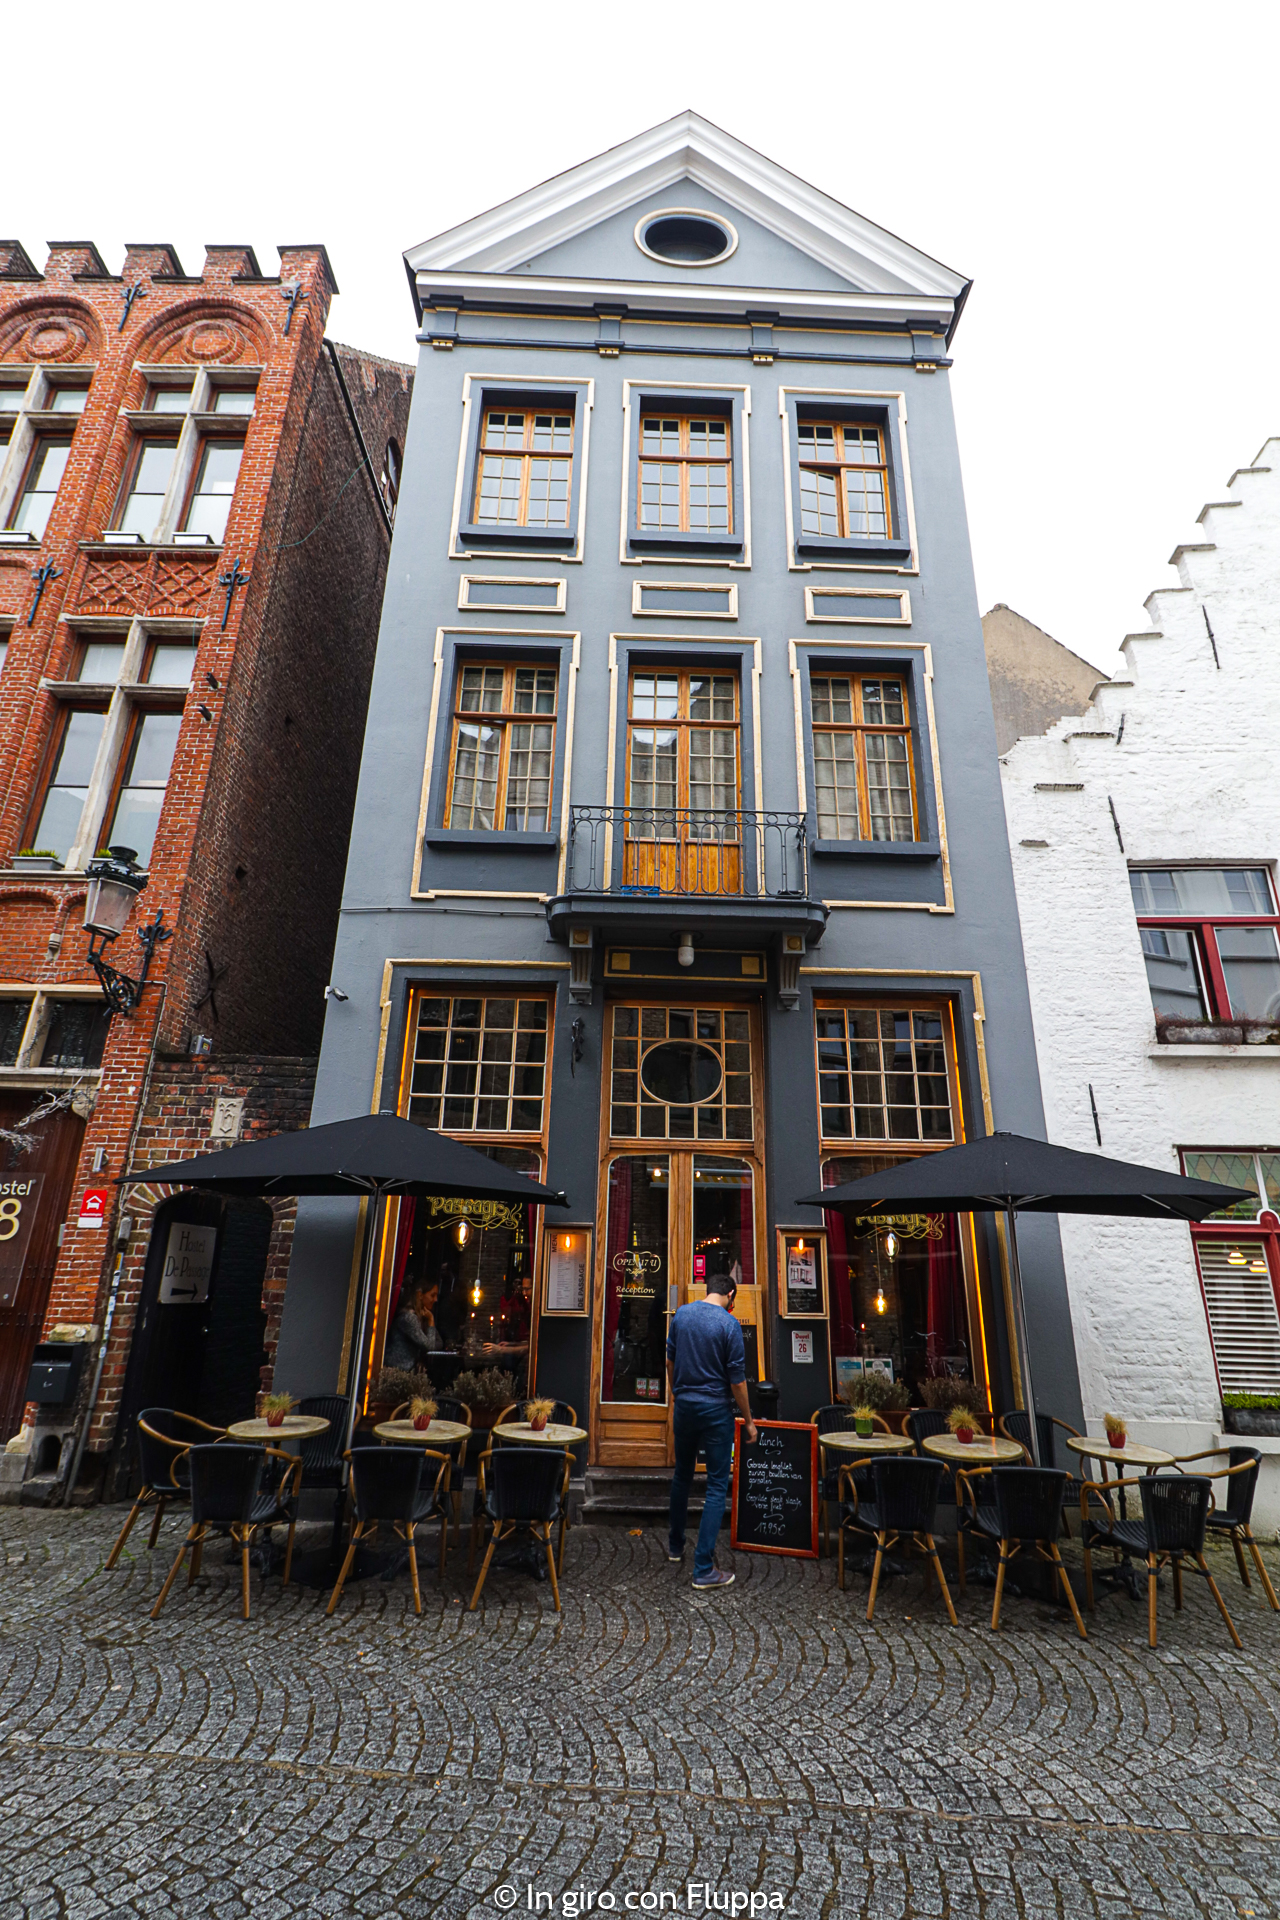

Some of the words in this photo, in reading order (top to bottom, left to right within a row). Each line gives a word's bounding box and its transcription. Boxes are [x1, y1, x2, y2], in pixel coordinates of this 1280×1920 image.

[0, 1180, 33, 1196] stel
[179, 1231, 206, 1253] Hostel
[165, 1255, 179, 1278] De
[615, 1285, 656, 1295] Reception
[578, 1296, 584, 1308] DE
[798, 1343, 807, 1353] 26
